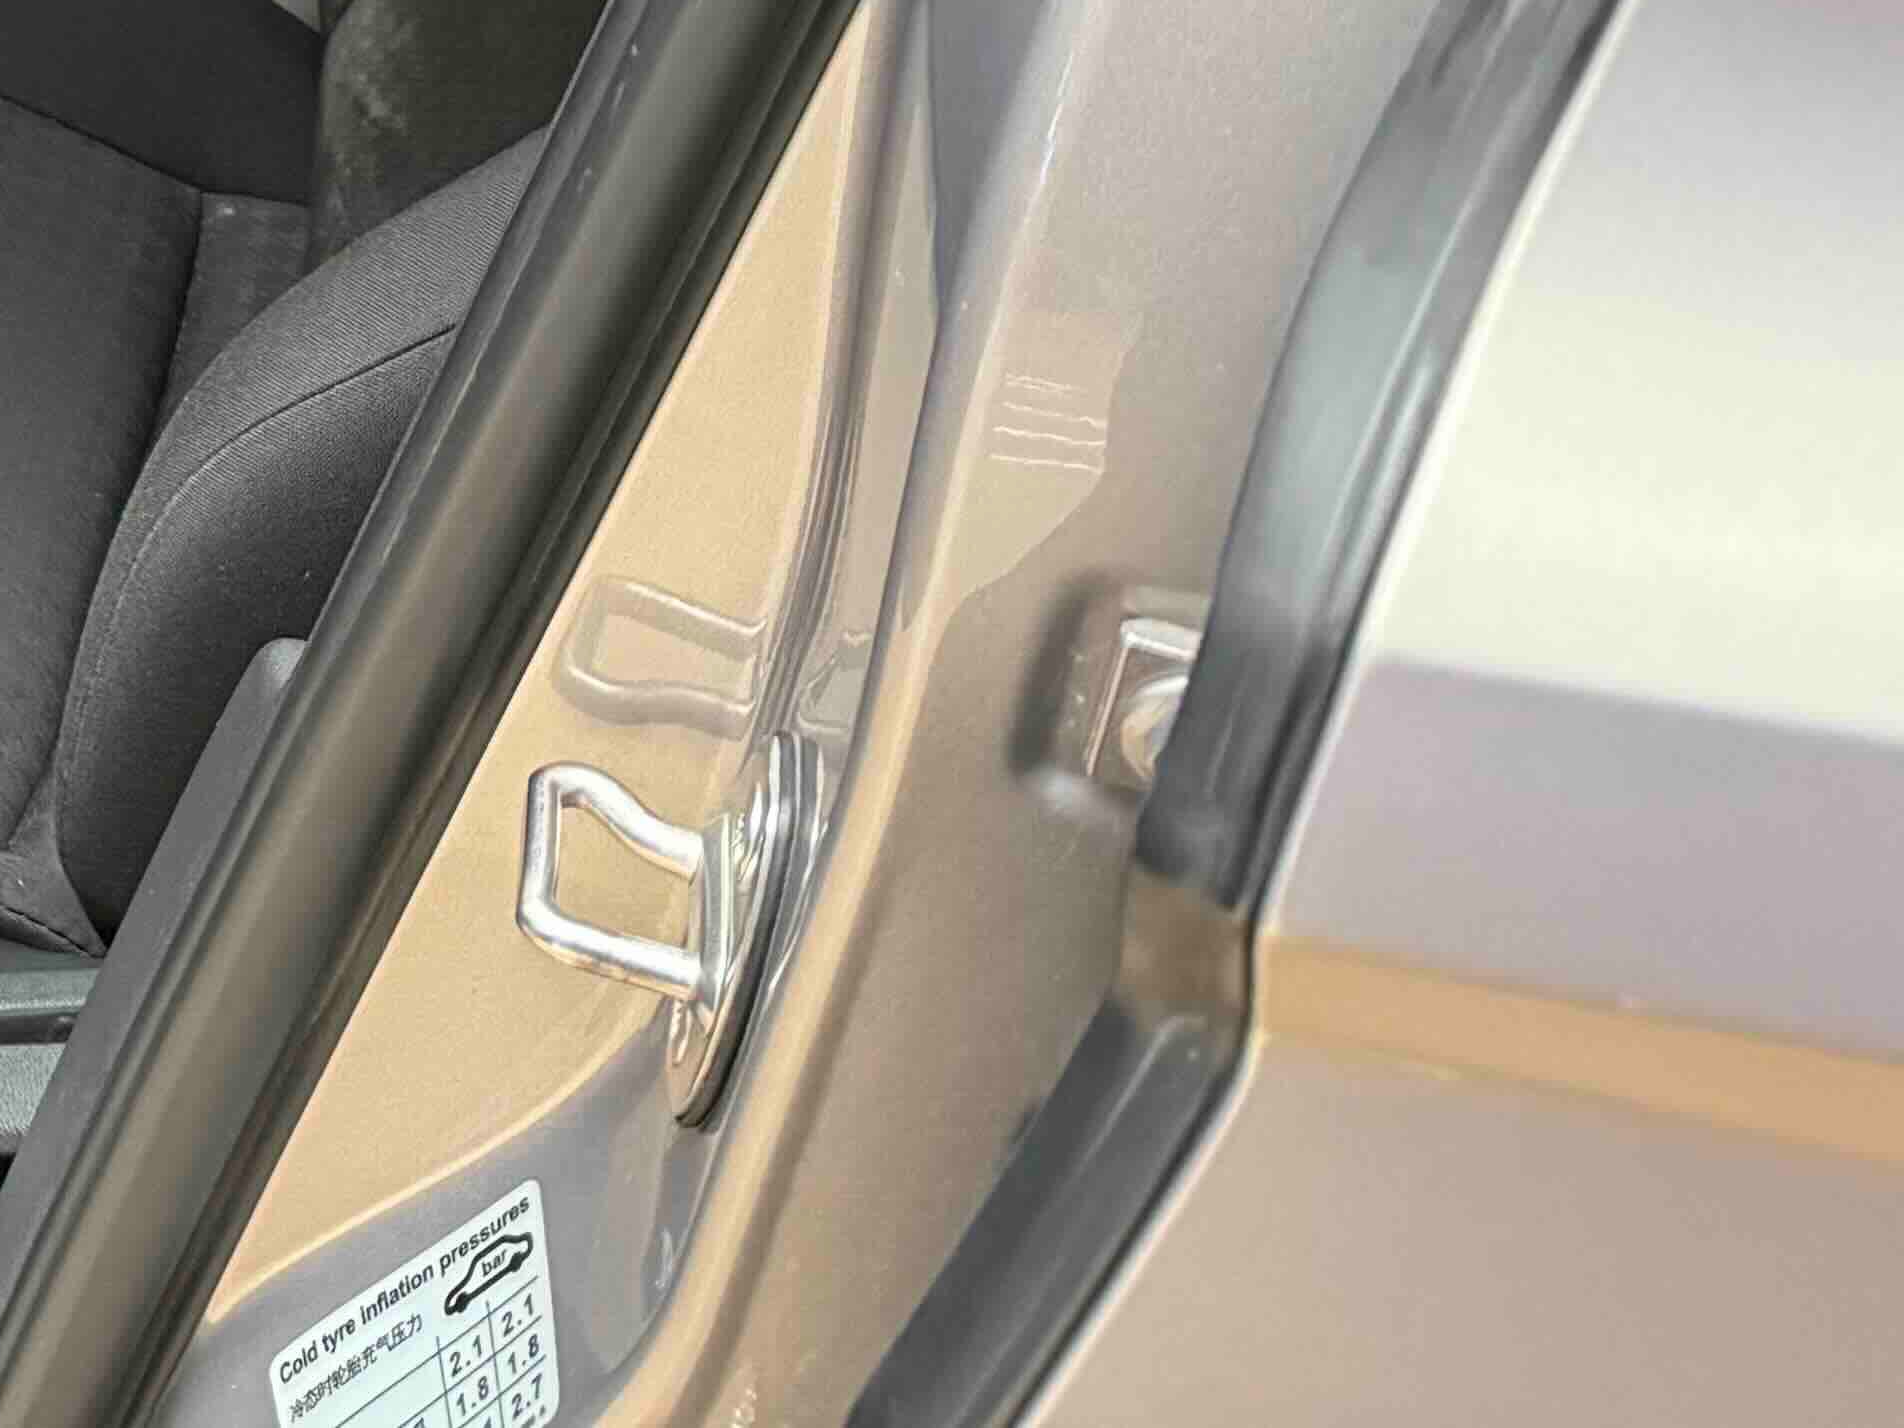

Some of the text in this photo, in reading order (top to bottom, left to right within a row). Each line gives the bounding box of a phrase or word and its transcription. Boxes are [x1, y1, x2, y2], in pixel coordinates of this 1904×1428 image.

[278, 1339, 319, 1384] Cold
[322, 1319, 356, 1353] tyre
[439, 1196, 531, 1278] pressures
[480, 1249, 509, 1278] bar
[449, 1293, 535, 1377] 2.1 2.1
[456, 1333, 540, 1416] 1.8 1.8
[511, 1372, 543, 1419] 2.7
